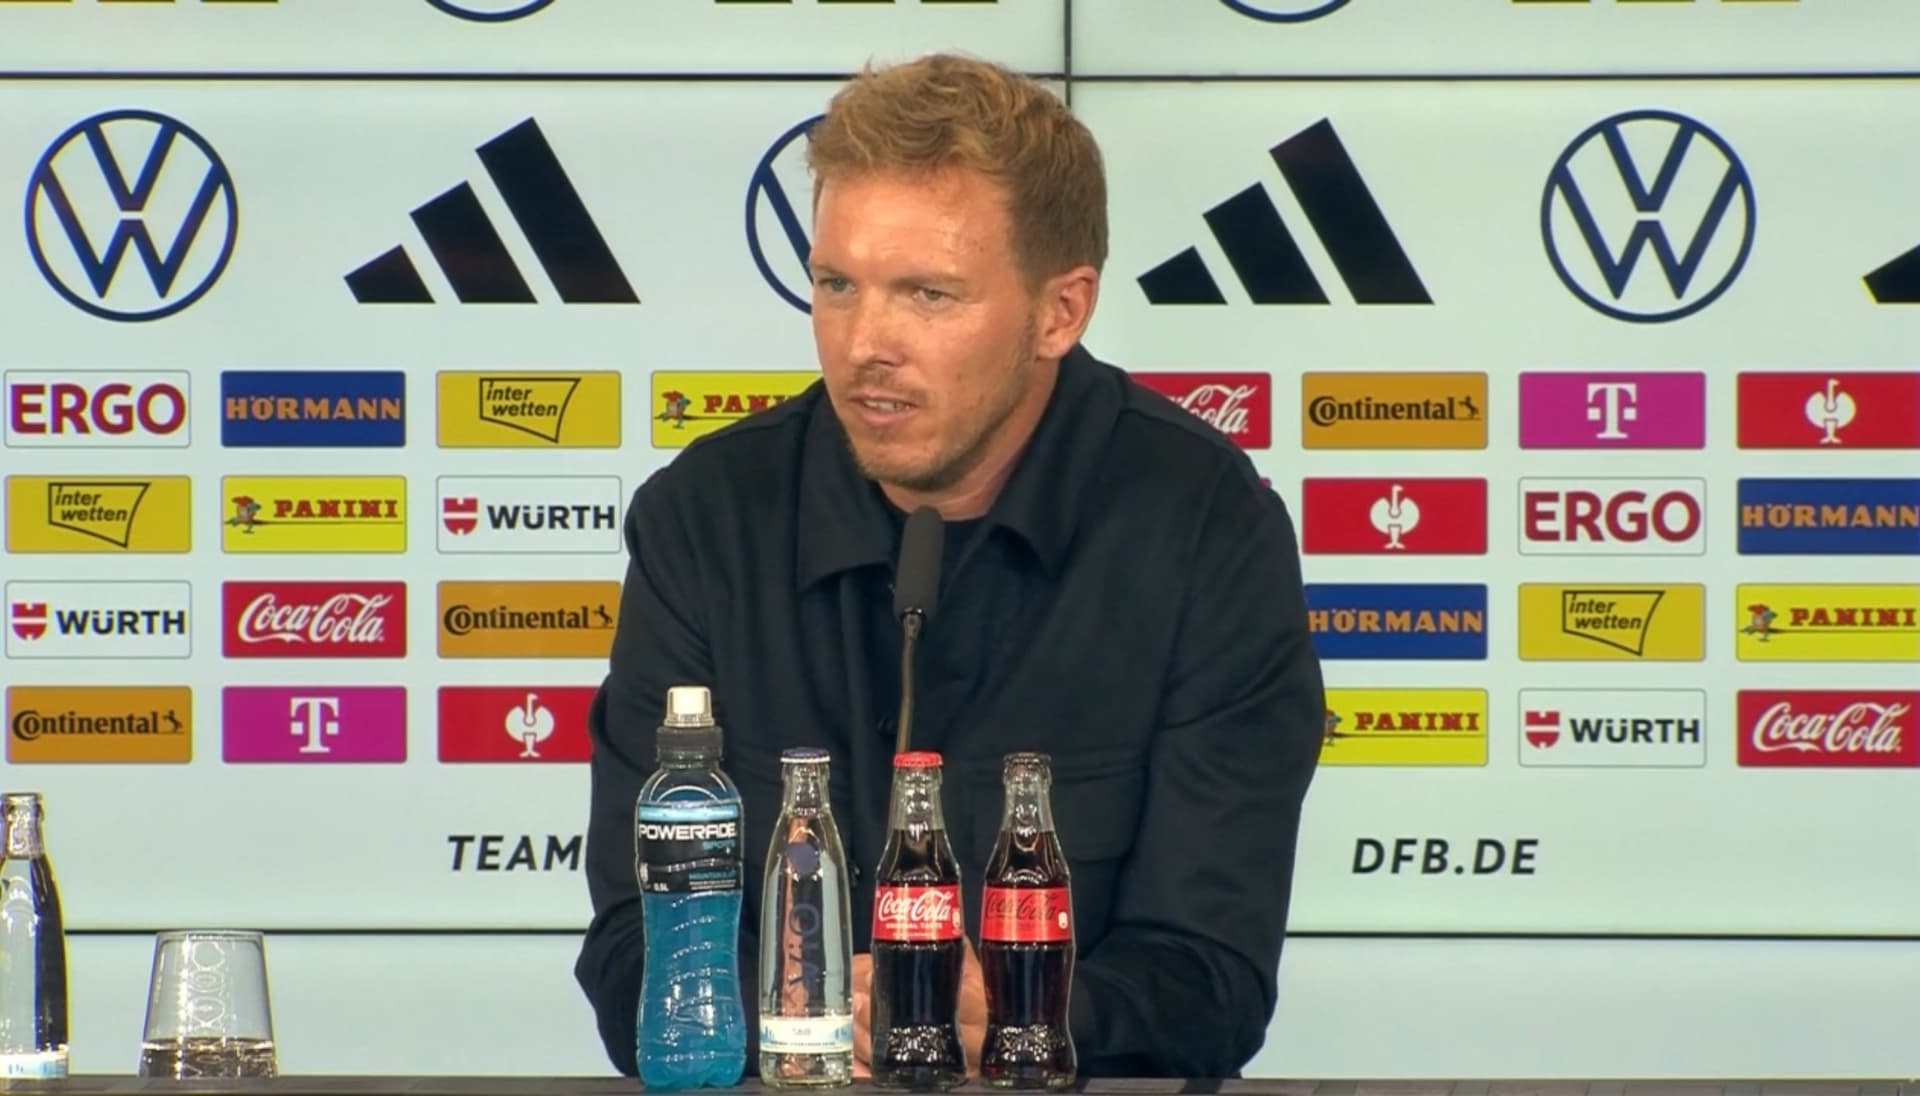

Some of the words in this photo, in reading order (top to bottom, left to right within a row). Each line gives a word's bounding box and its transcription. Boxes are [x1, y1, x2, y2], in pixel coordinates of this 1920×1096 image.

[486, 381, 533, 401] inter
[10, 382, 187, 435] ERGO
[226, 393, 401, 421] HÖRMANN
[491, 403, 559, 417] wetten
[1308, 396, 1456, 427] Continental
[54, 486, 102, 507] inter
[273, 498, 399, 519] PANINI
[60, 505, 128, 522] wetten
[486, 504, 616, 530] WÜRTH
[1524, 490, 1702, 543] ERGO
[1741, 503, 1919, 528] HÖRMANN
[1568, 592, 1617, 614] inter
[56, 609, 186, 635] WÜRTH
[237, 593, 393, 643] Coca-Cola
[443, 604, 590, 637] Continental
[1307, 607, 1483, 633] HÖRMANN
[1574, 615, 1643, 630] wetten
[1789, 607, 1917, 627] PANINI
[12, 709, 159, 742] Continental
[1354, 712, 1480, 732] PANINI
[1569, 717, 1700, 744] WÜRTH
[1752, 701, 1911, 753] Coca-Cola
[638, 822, 737, 840] POWERADE
[447, 835, 583, 871] TEAM
[1352, 837, 1540, 875] DFB.DE
[878, 889, 954, 922] Coca-Cola
[985, 891, 1058, 921] Coca-Cola
